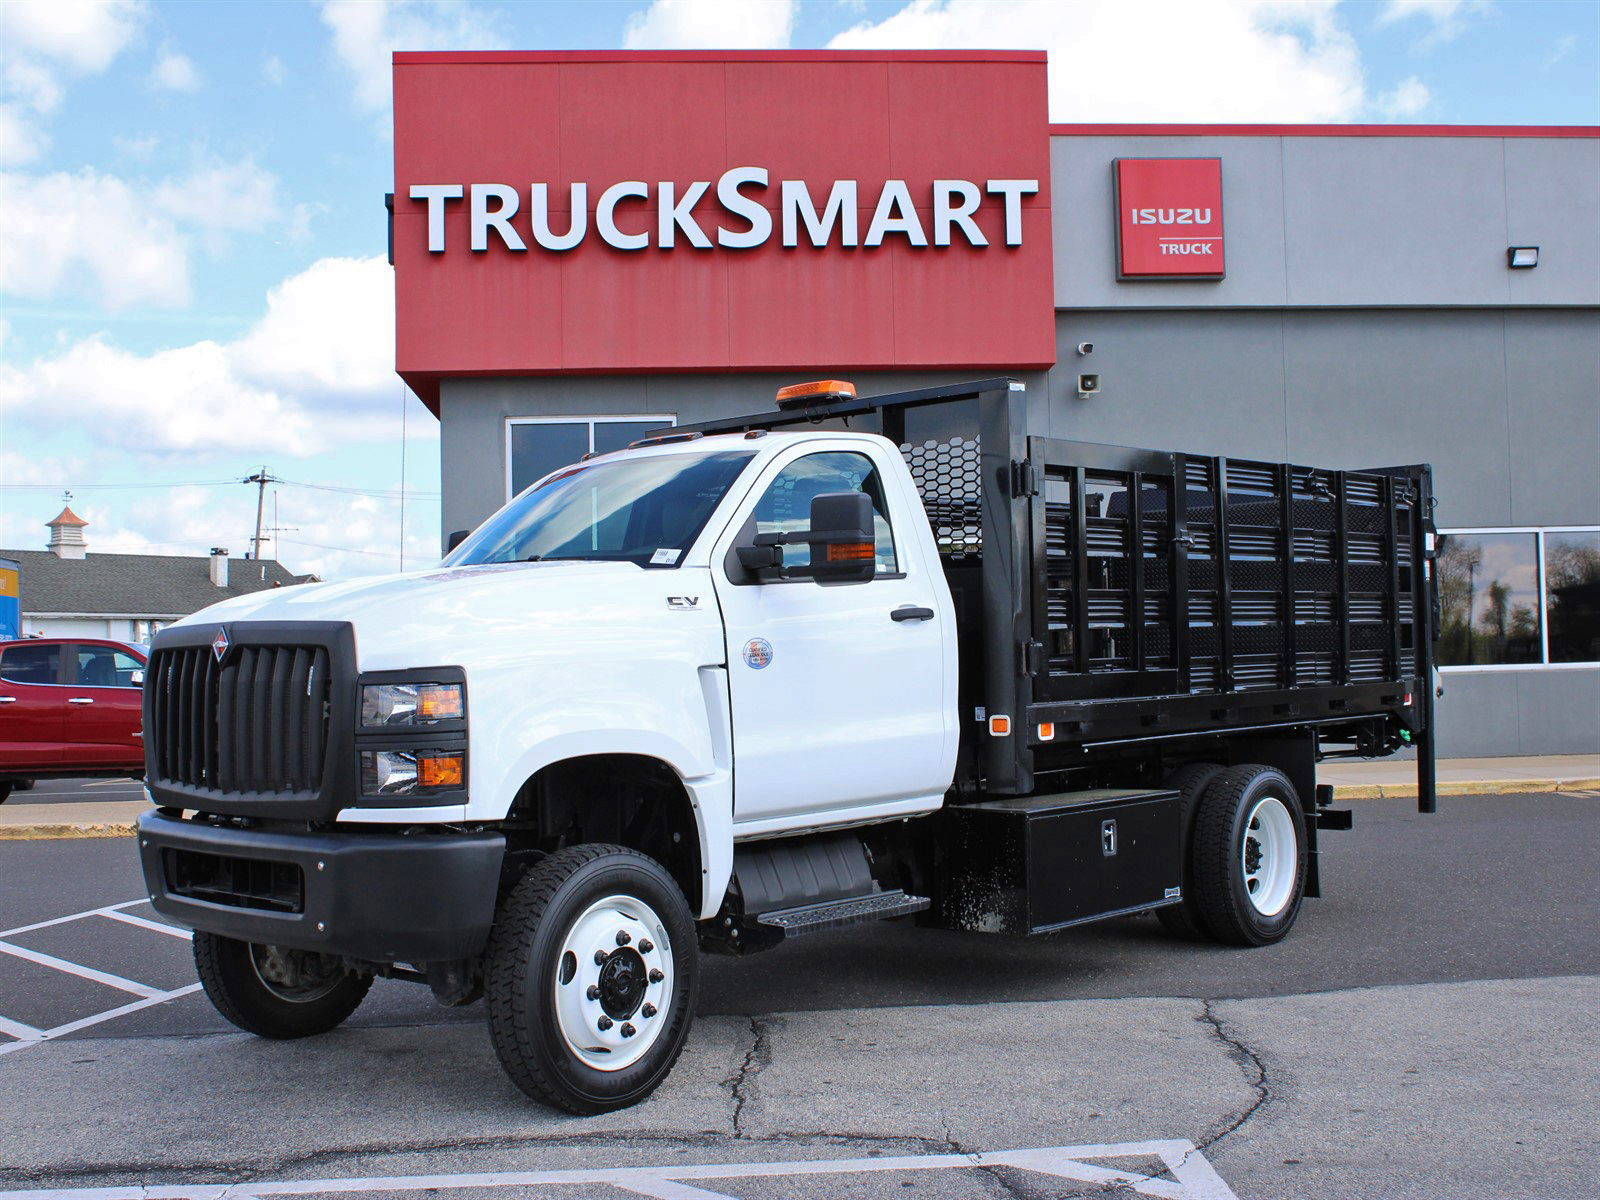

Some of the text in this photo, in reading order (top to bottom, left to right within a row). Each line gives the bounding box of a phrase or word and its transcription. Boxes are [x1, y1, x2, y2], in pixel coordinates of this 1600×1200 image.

[408, 166, 1039, 252] TRUCKSMART
[1131, 208, 1211, 225] ISUZU
[1159, 243, 1212, 255] TRUCK
[667, 596, 699, 606] CV
